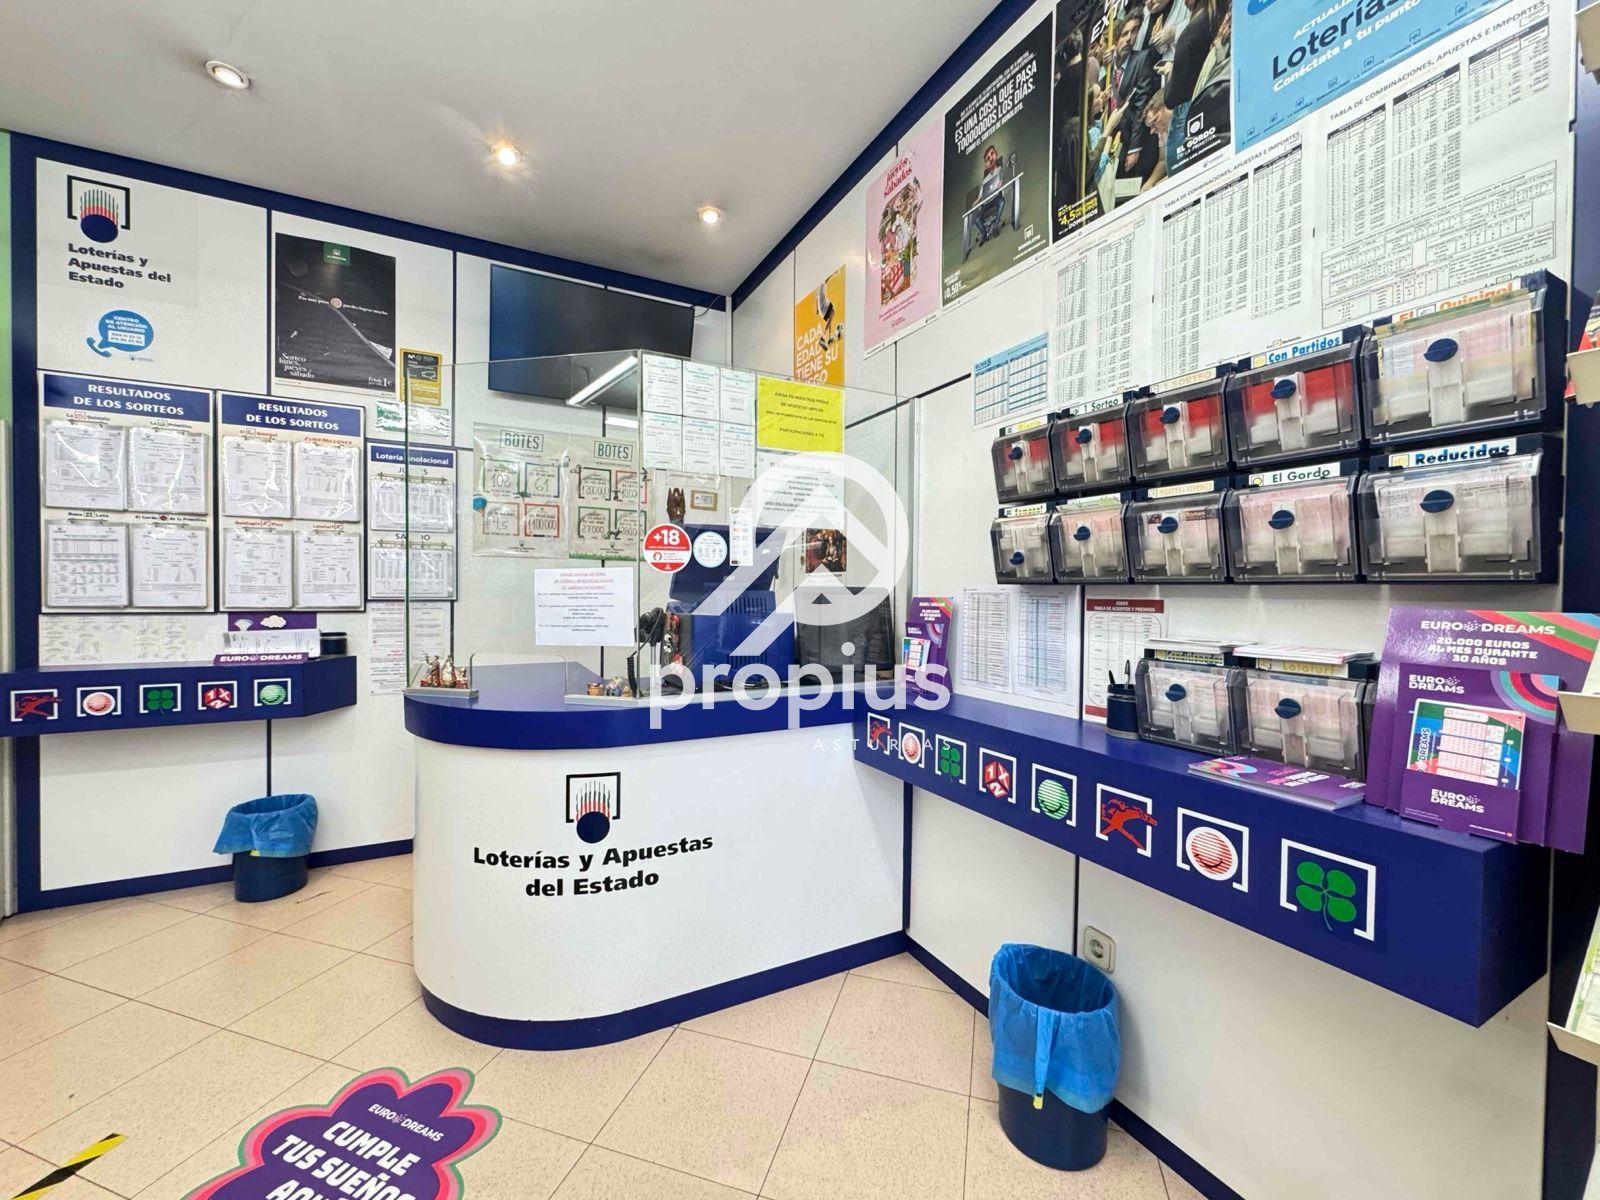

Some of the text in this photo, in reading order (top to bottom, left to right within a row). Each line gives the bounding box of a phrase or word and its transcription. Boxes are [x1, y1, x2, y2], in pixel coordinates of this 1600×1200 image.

[1270, 48, 1336, 92] Conéctate
[1340, 39, 1349, 49] a
[1352, 23, 1369, 41] tu
[1329, 106, 1354, 121] TABLA
[1354, 98, 1364, 109] DE
[1365, 59, 1435, 102] COMBINACIONES,
[1436, 32, 1483, 63] APUESTAS
[1492, 2, 1546, 31] IMPORTES
[955, 59, 1037, 143] ES UNA COSA QUE PASA
[998, 95, 1013, 119] LOS
[1176, 126, 1216, 155] EL GORDO
[1192, 134, 1216, 151] PRIMITIVA
[1164, 197, 1180, 208] TABLA
[1233, 151, 1263, 172] APUESTAS
[1268, 131, 1300, 152] IMPORTES
[68, 243, 149, 268] Loterías y
[67, 257, 172, 283] Apuestas del
[68, 271, 125, 288] Estado
[797, 323, 826, 351] CADA
[797, 341, 822, 368] EDAD
[1268, 335, 1340, 363] Con Partidos
[796, 346, 838, 380] TIENE SU
[1171, 371, 1213, 386] SORTEO
[88, 384, 171, 401] RESULTADOS
[73, 396, 184, 416] DE LOS SORTEOS
[258, 402, 328, 418] RESULTADOS
[1091, 398, 1119, 411] Sorteo
[246, 413, 340, 431] DE LOS SORTEOS
[504, 432, 540, 450] BOTES
[598, 444, 629, 460] BOTES
[1414, 444, 1510, 465] Reducidas
[1272, 467, 1330, 483] El Gordo
[653, 529, 680, 545] +18
[1420, 620, 1556, 635] EURO DREAMS
[1427, 644, 1538, 659] AL MES DURANTE
[1436, 636, 1530, 649] 20.000 EUROS
[1452, 654, 1507, 666] 30 AÑOS
[1408, 674, 1445, 685] EURO
[1408, 681, 1465, 694] DREAMS
[1418, 727, 1431, 761] DREAMS
[1430, 796, 1485, 814] DREAMS
[1431, 788, 1466, 802] EURO
[473, 836, 713, 872] Loterías y Apuestas
[525, 870, 659, 897] del Estado
[368, 1103, 445, 1142] EURO DREAMS
[271, 1133, 327, 1170] TUS
[322, 1120, 421, 1177] CUMPLE
